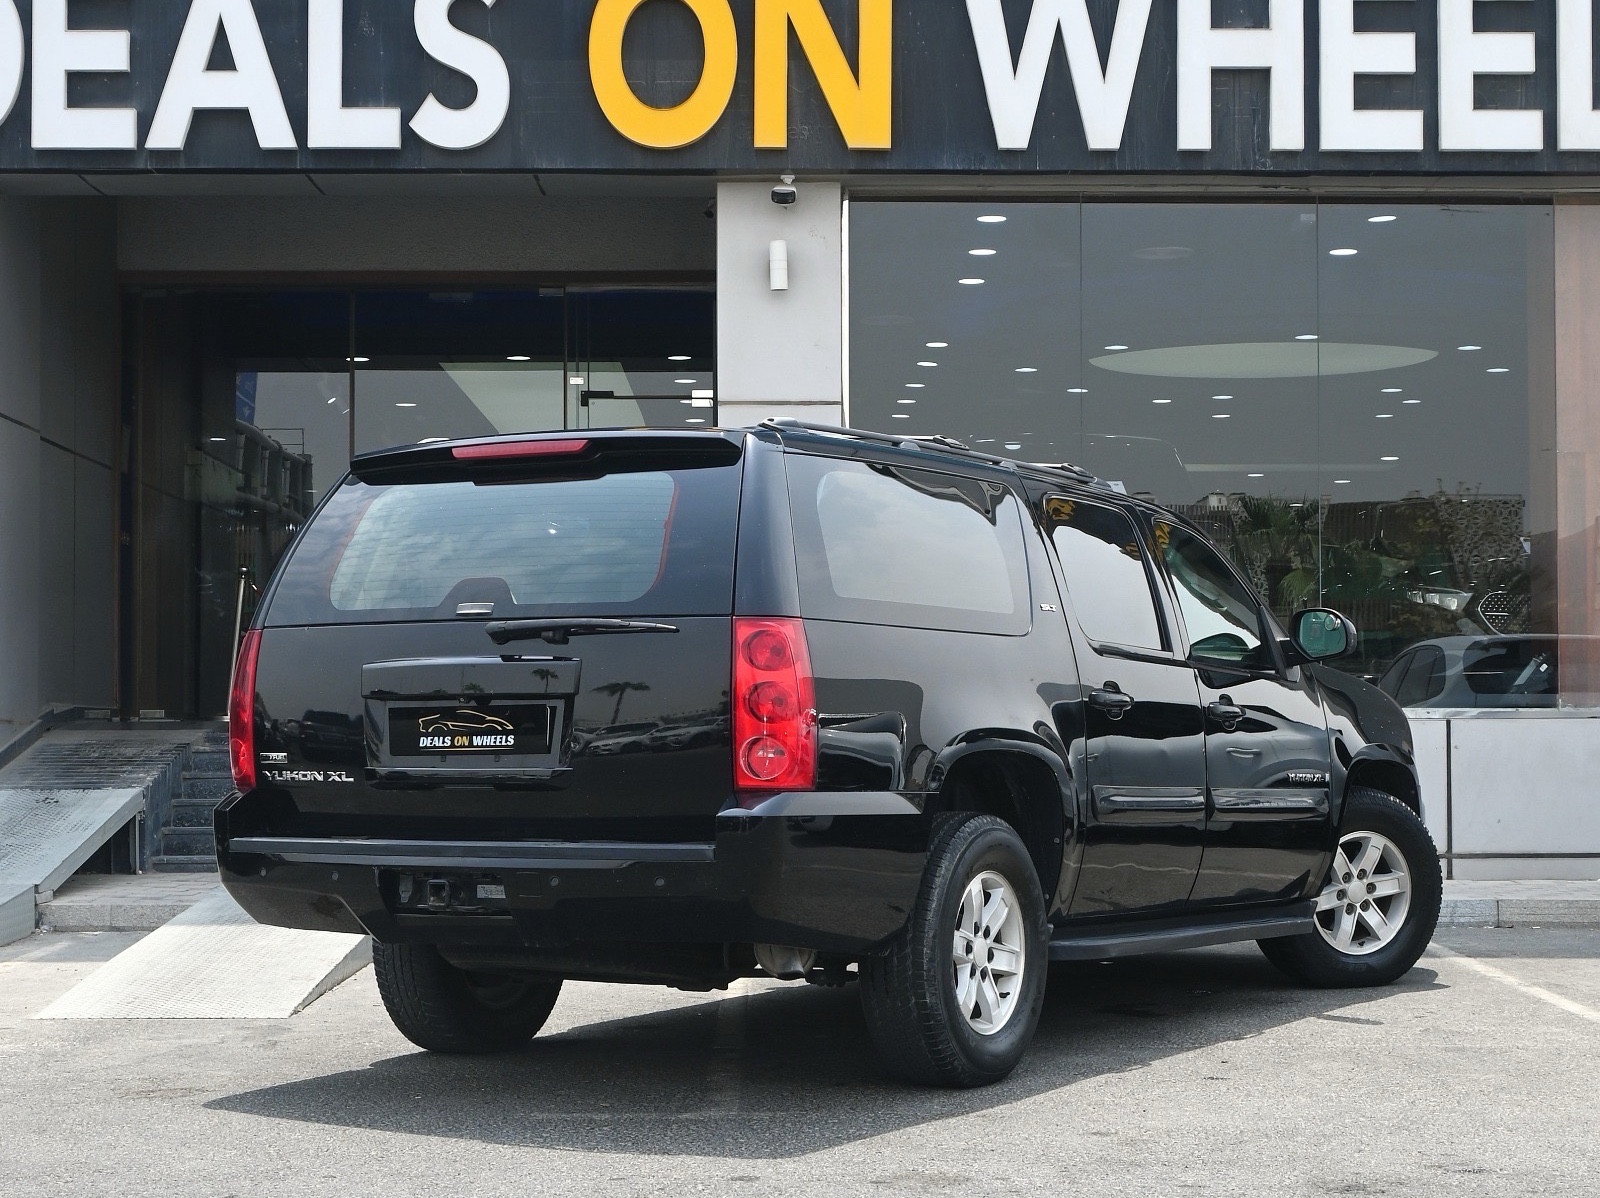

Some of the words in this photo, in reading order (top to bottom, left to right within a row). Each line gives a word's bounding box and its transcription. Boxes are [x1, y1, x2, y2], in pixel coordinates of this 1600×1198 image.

[0, 0, 510, 151] EALS
[588, 0, 892, 150] ON
[419, 736, 452, 747] DEALS
[454, 735, 470, 746] ON
[472, 735, 515, 746] WHEELS
[262, 771, 323, 782] YUKON
[326, 771, 354, 782] XL
